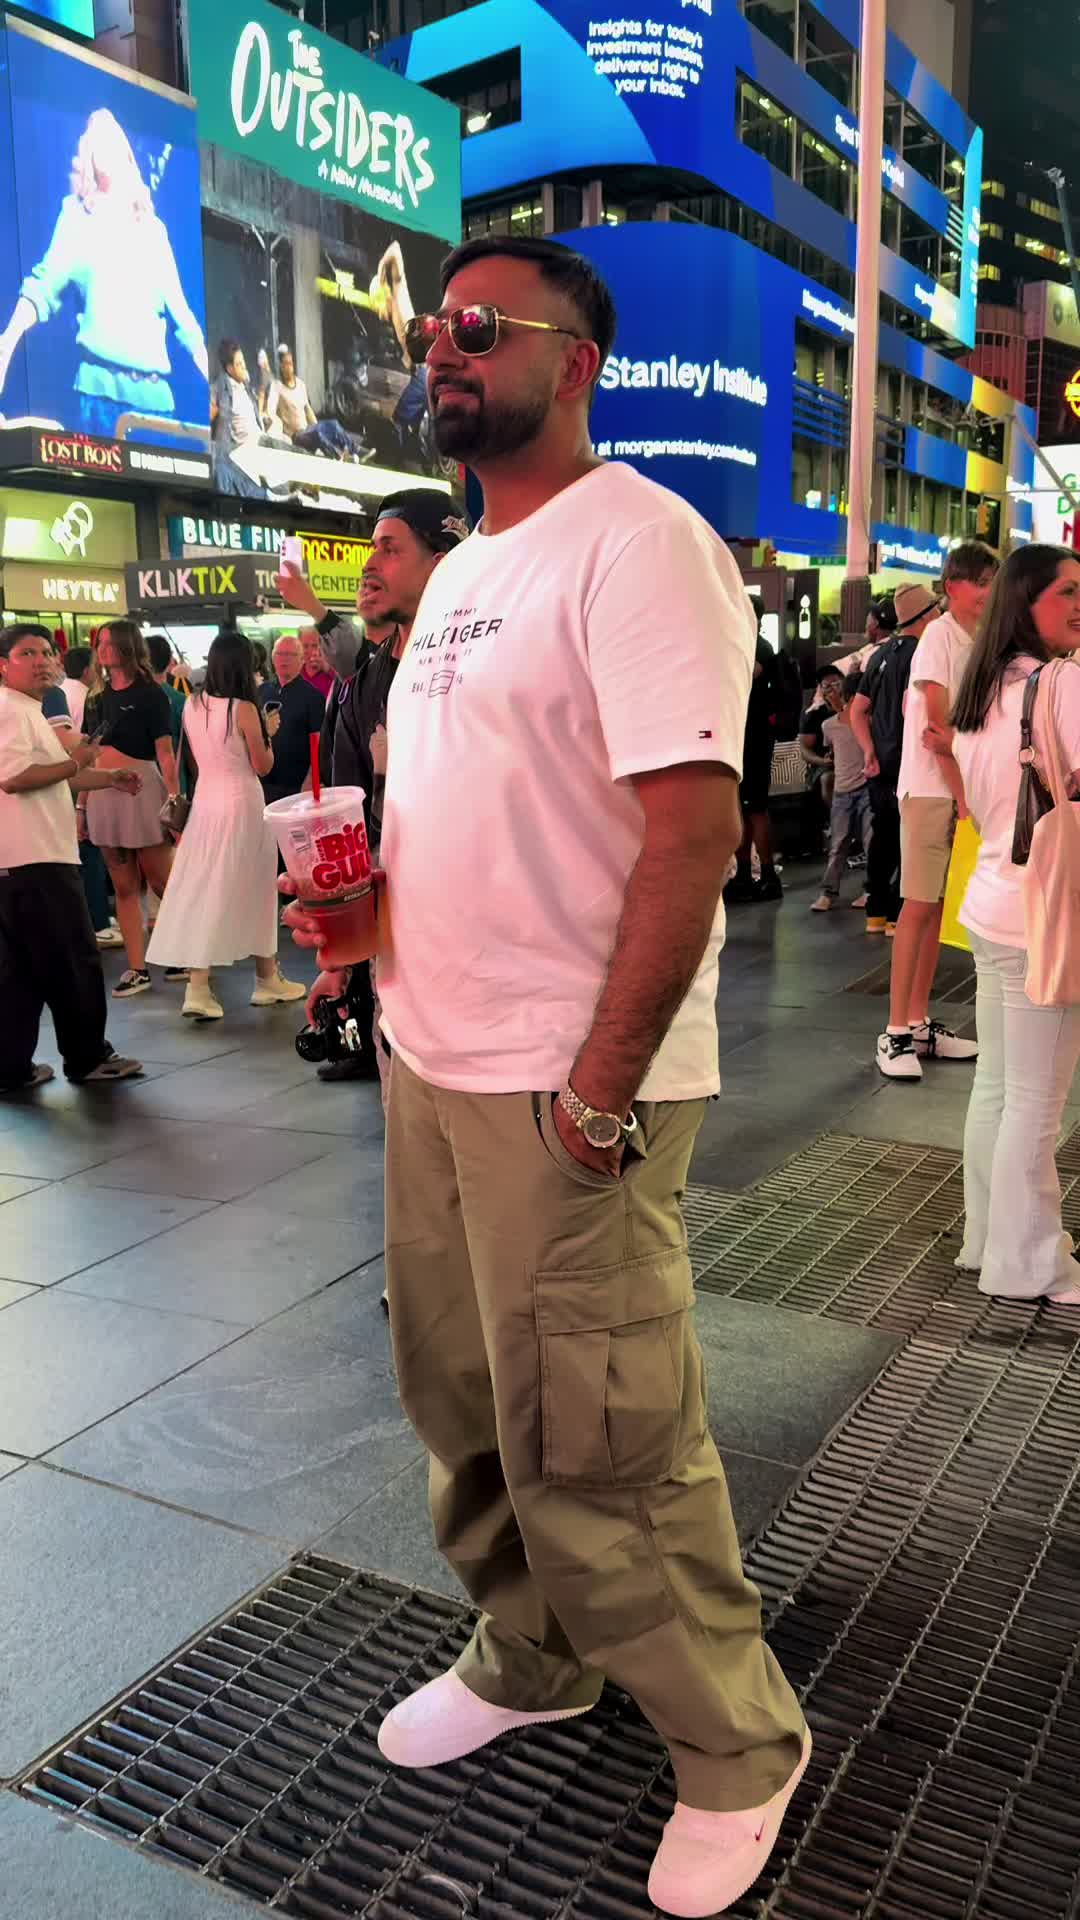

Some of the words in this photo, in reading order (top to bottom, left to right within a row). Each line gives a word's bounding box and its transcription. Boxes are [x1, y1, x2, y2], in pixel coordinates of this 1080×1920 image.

[589, 19, 642, 38] Insights
[645, 19, 664, 36] for
[594, 57, 658, 74] delivered
[661, 61, 688, 80] right
[690, 69, 700, 84] to
[615, 79, 646, 96] your
[231, 22, 434, 208] OUTSIDERS
[317, 159, 328, 179] A
[330, 165, 356, 188] NEW
[358, 176, 404, 211] MUSICAL
[600, 355, 710, 397] Stanley
[40, 437, 82, 463] LOST
[83, 444, 124, 473] BOYS
[598, 441, 611, 456] at
[182, 516, 243, 548] BLUE
[252, 528, 285, 552] FIN
[42, 578, 116, 603] HEYTEA
[138, 565, 238, 599] KLIKTIX
[411, 618, 503, 653] HILFIGER
